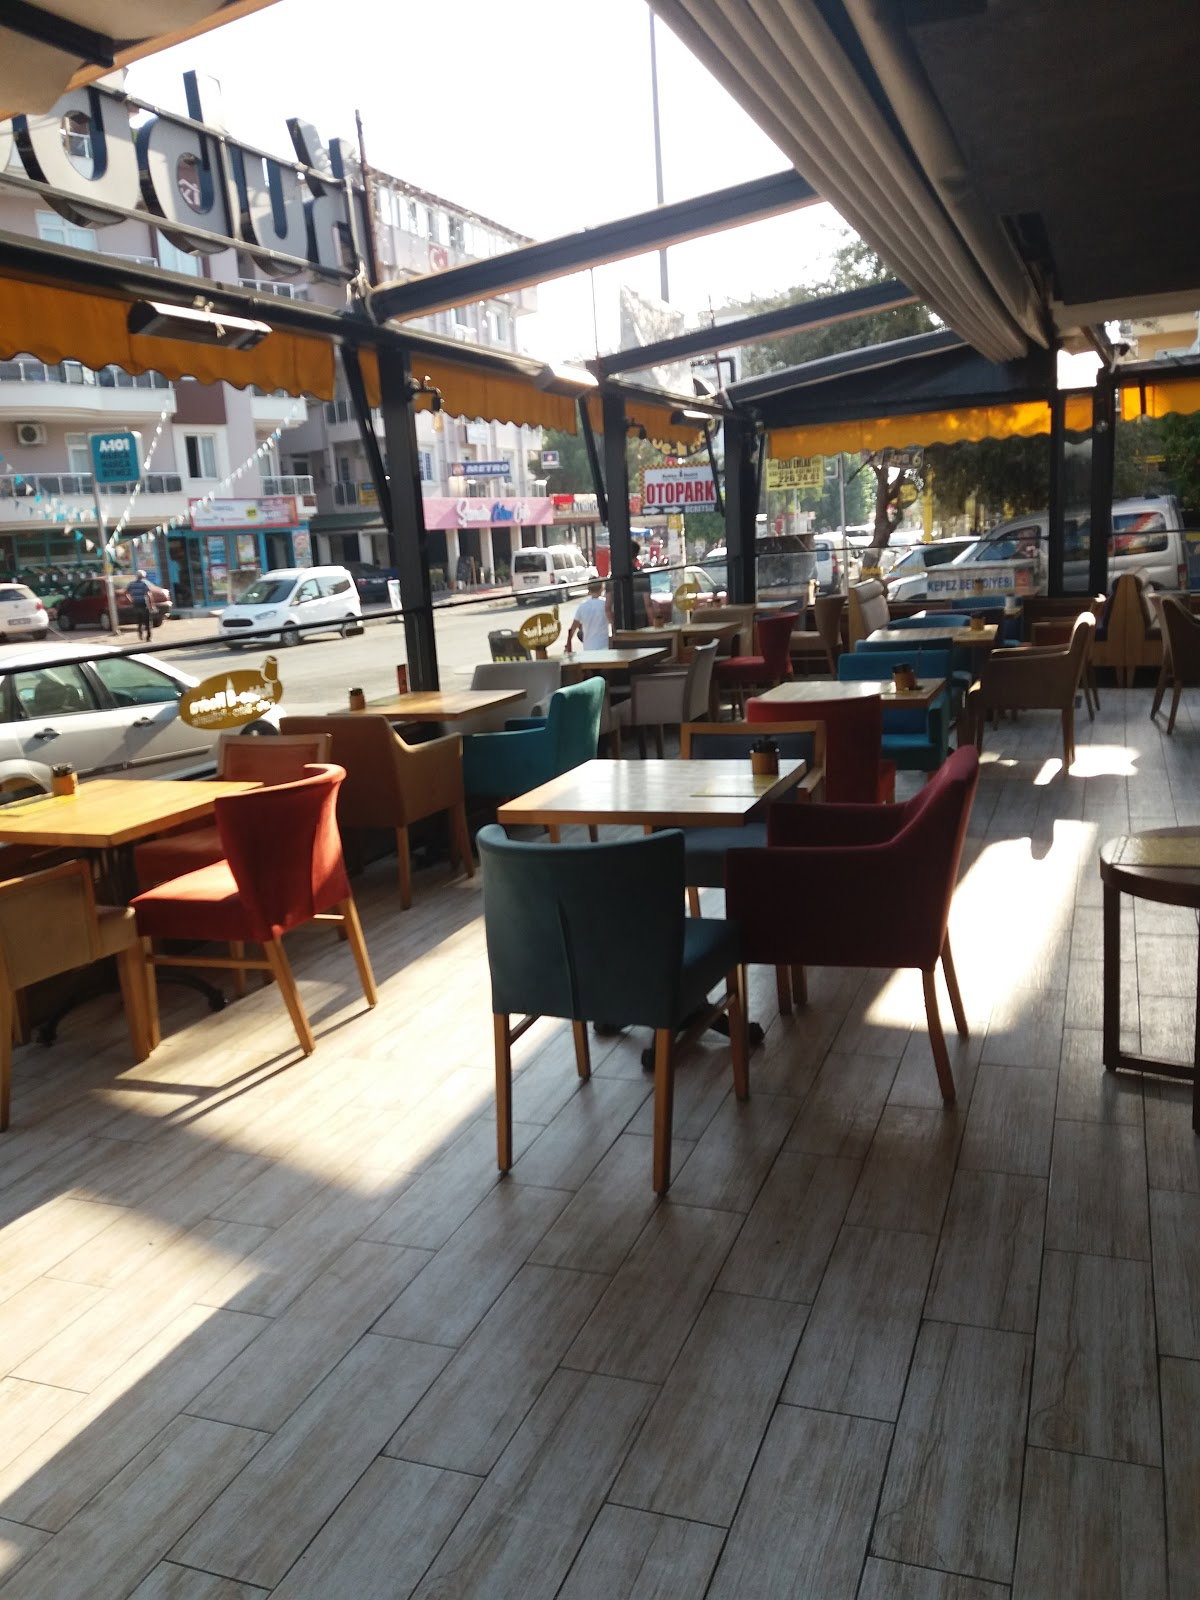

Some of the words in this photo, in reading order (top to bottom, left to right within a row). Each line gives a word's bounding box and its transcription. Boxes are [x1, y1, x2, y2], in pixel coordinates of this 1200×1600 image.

[466, 463, 509, 473] METRO
[646, 480, 715, 504] OTOPARK
[927, 579, 957, 592] KEPEZ
